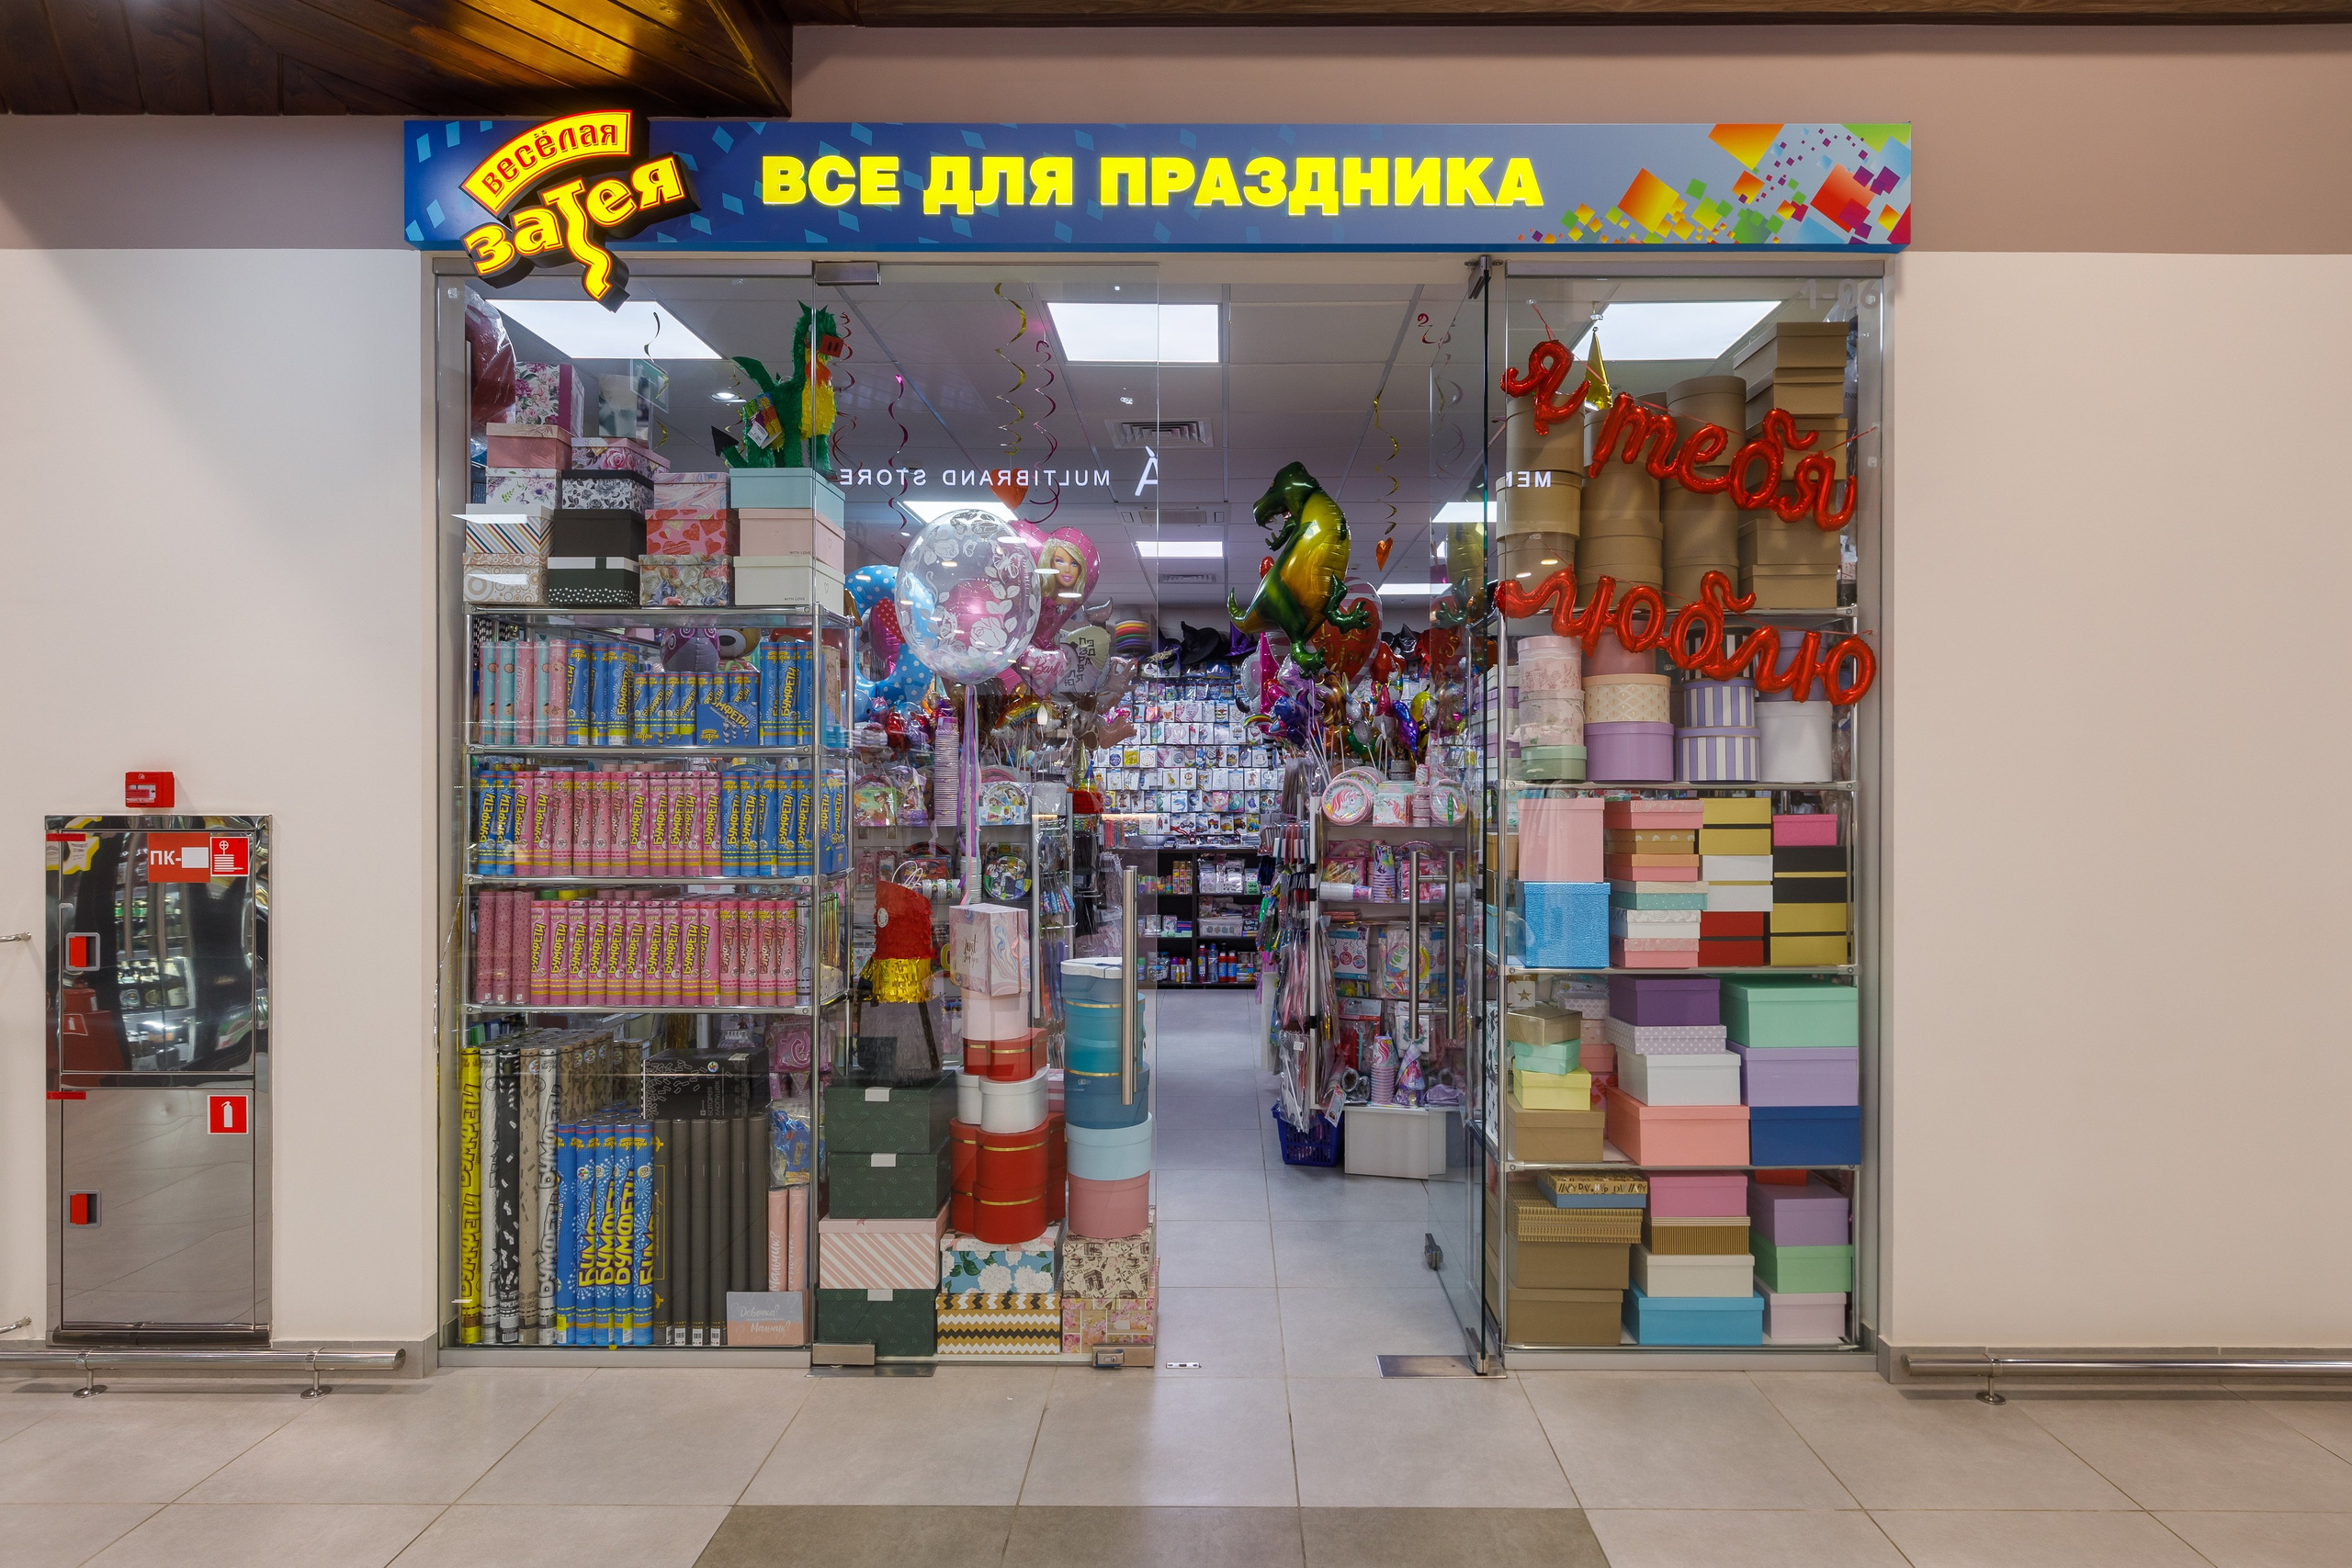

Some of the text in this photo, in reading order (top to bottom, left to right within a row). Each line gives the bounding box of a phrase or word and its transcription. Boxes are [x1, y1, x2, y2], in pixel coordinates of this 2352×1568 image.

[762, 155, 1545, 216] ВСЕ ДЛЯ ПРАЗДНИКА
[781, 666, 797, 717] БУМФЕТИ
[629, 794, 647, 845] БУМФЕТИ
[703, 794, 720, 845] БУМФЕТИ
[741, 794, 757, 845] БУМФЕТИ
[778, 794, 796, 844] БУМФЕТИ
[797, 794, 812, 844] БУМФЕТИ
[150, 850, 182, 865] ПК-
[550, 922, 568, 974] БУМФЕТИ
[570, 922, 587, 975] БУМФЕТИ
[589, 922, 606, 974] БУМФЕТИ
[607, 922, 625, 974] БУМФЕТИ
[626, 922, 646, 974] БУМФЕТИ
[646, 923, 663, 975] БУМФЕТИ
[663, 922, 681, 974] БУМФЕТИ
[683, 923, 699, 975] БУМФЕТИ
